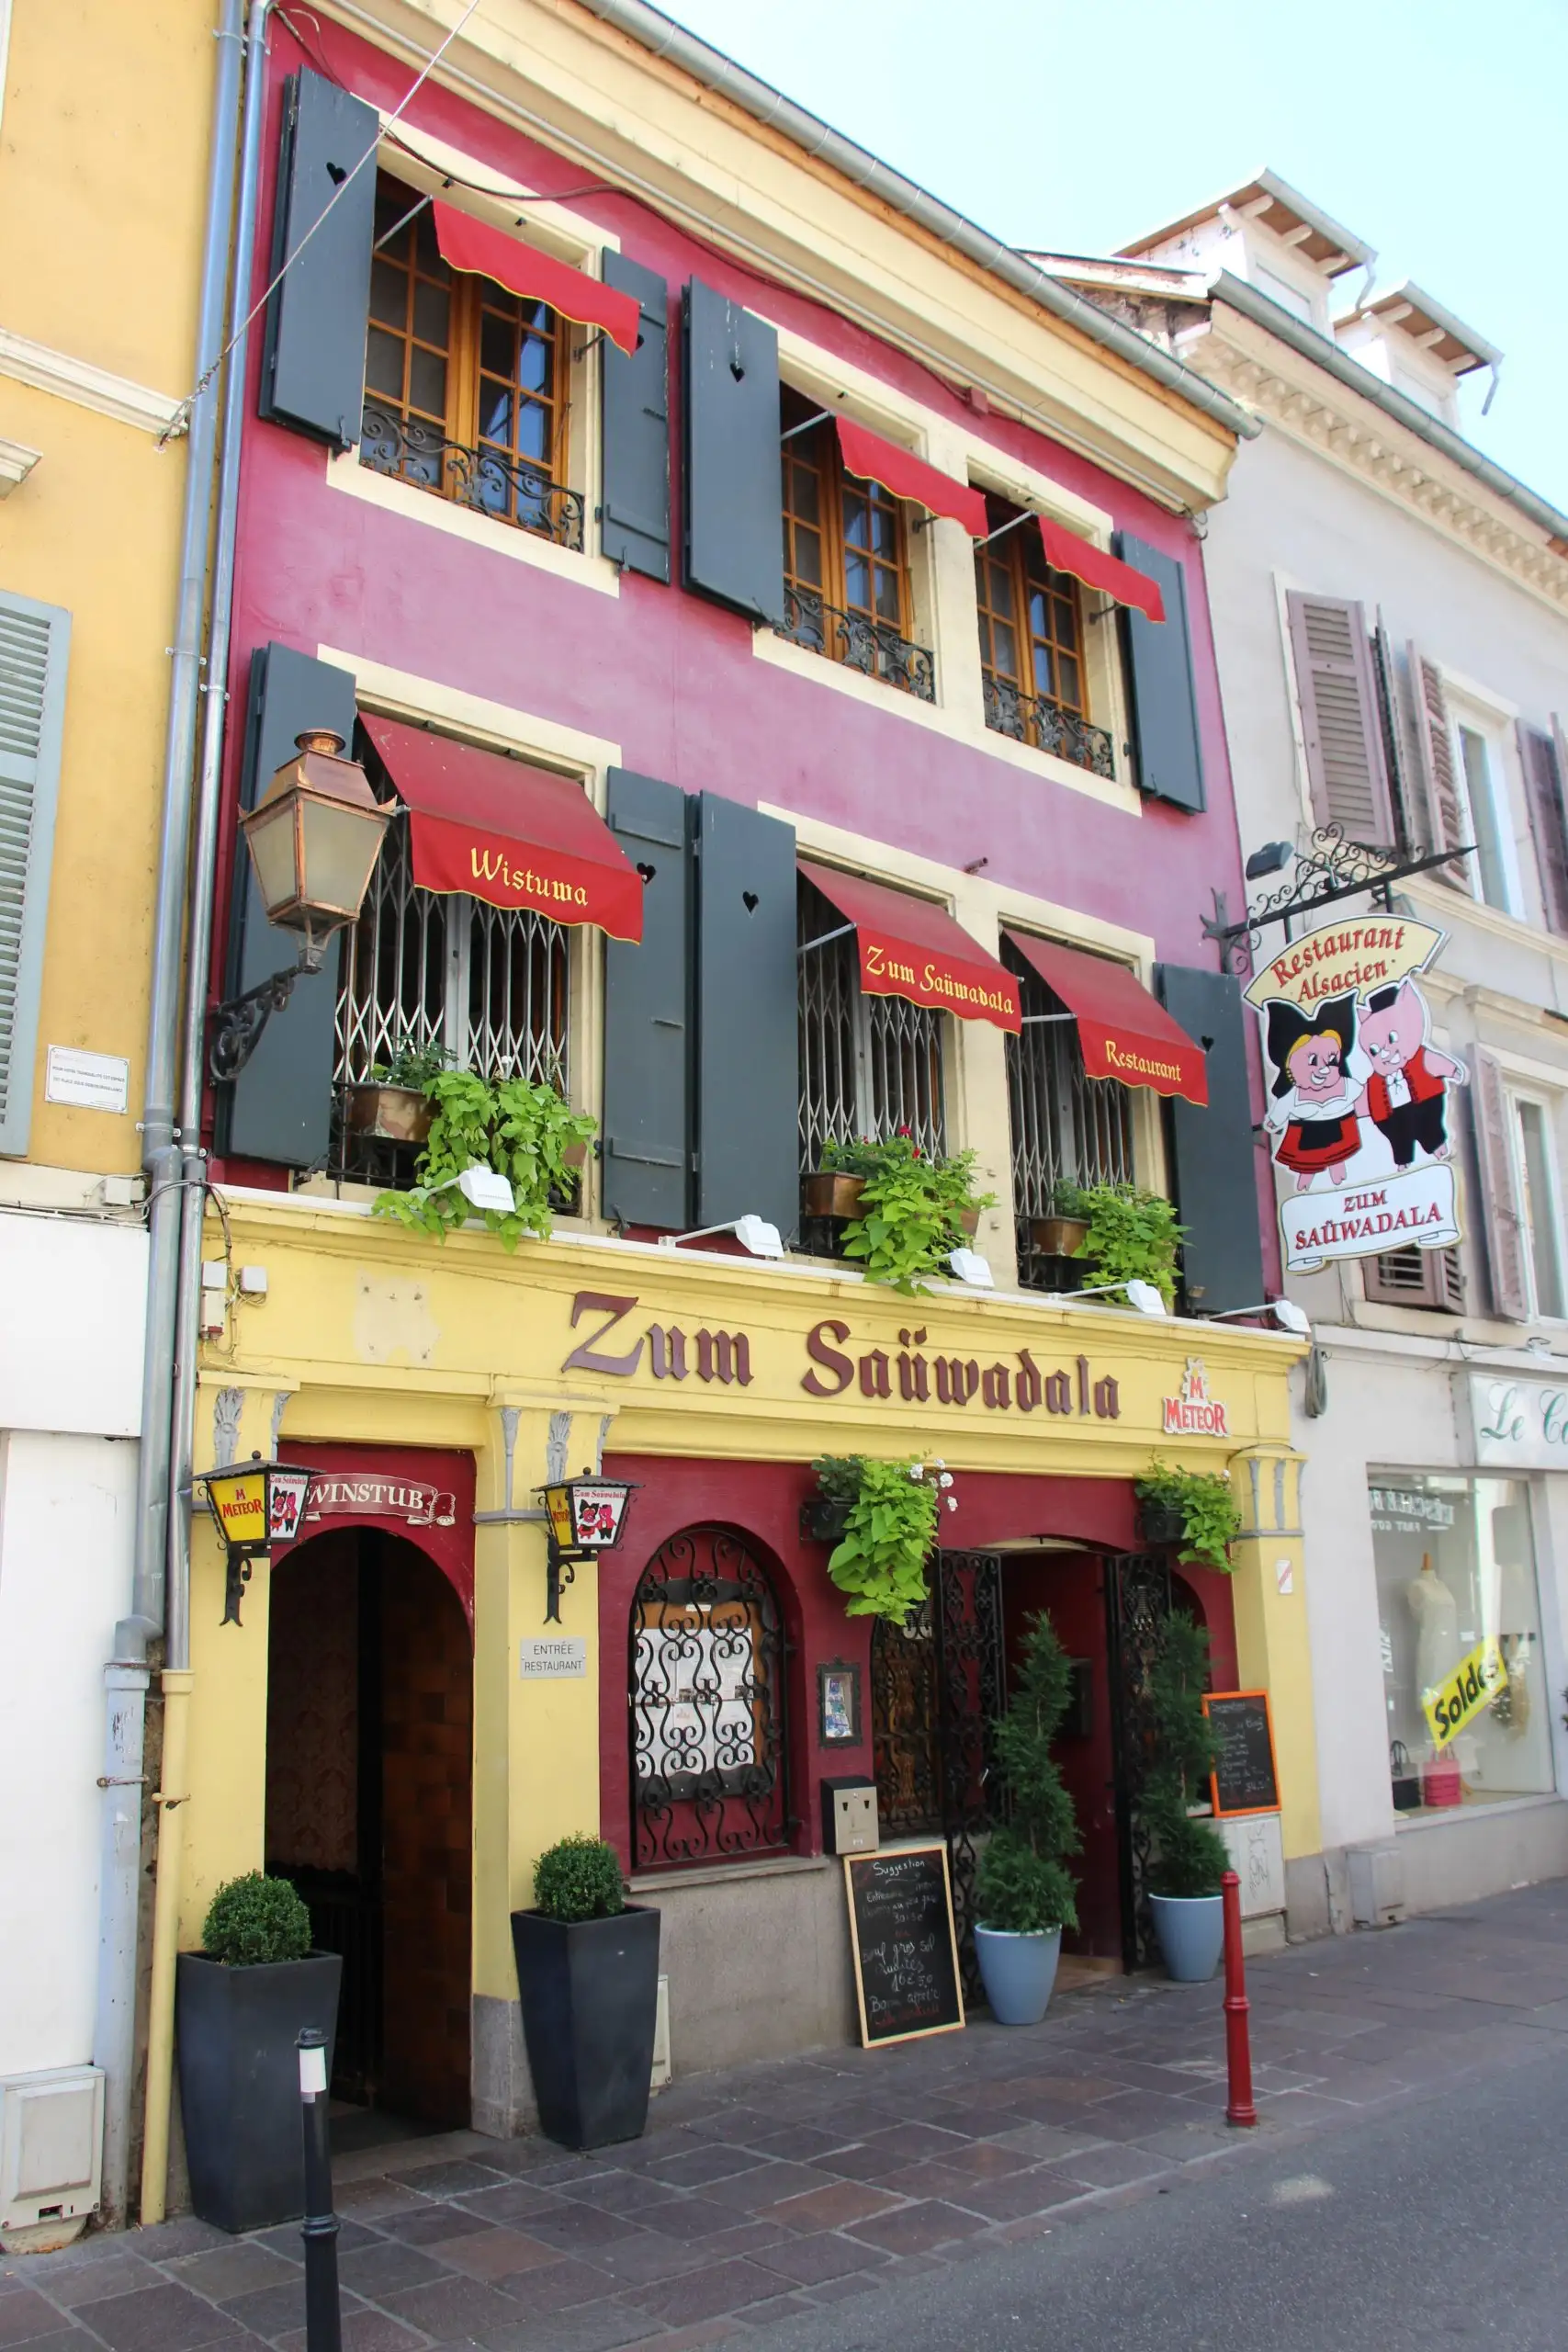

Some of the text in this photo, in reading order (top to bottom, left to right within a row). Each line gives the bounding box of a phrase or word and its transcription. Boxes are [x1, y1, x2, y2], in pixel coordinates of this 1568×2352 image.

[1270, 925, 1405, 988] Restaurant
[866, 945, 1014, 1014] Zum Saüwadala
[1297, 959, 1388, 1003] Alsacien
[1105, 1040, 1182, 1082] Restaurant
[1343, 1189, 1388, 1214] ZUM
[1294, 1202, 1444, 1250] SAÜWADALA
[561, 1290, 1122, 1419] Zum Saüwadala
[1165, 1397, 1227, 1434] METEOR
[1480, 1382, 1525, 1442] Le
[222, 1498, 264, 1519] METEOR
[525, 1660, 582, 1672] RESTAURANT
[533, 1640, 575, 1656] ENTRÉE
[1435, 1650, 1499, 1739] Sold
